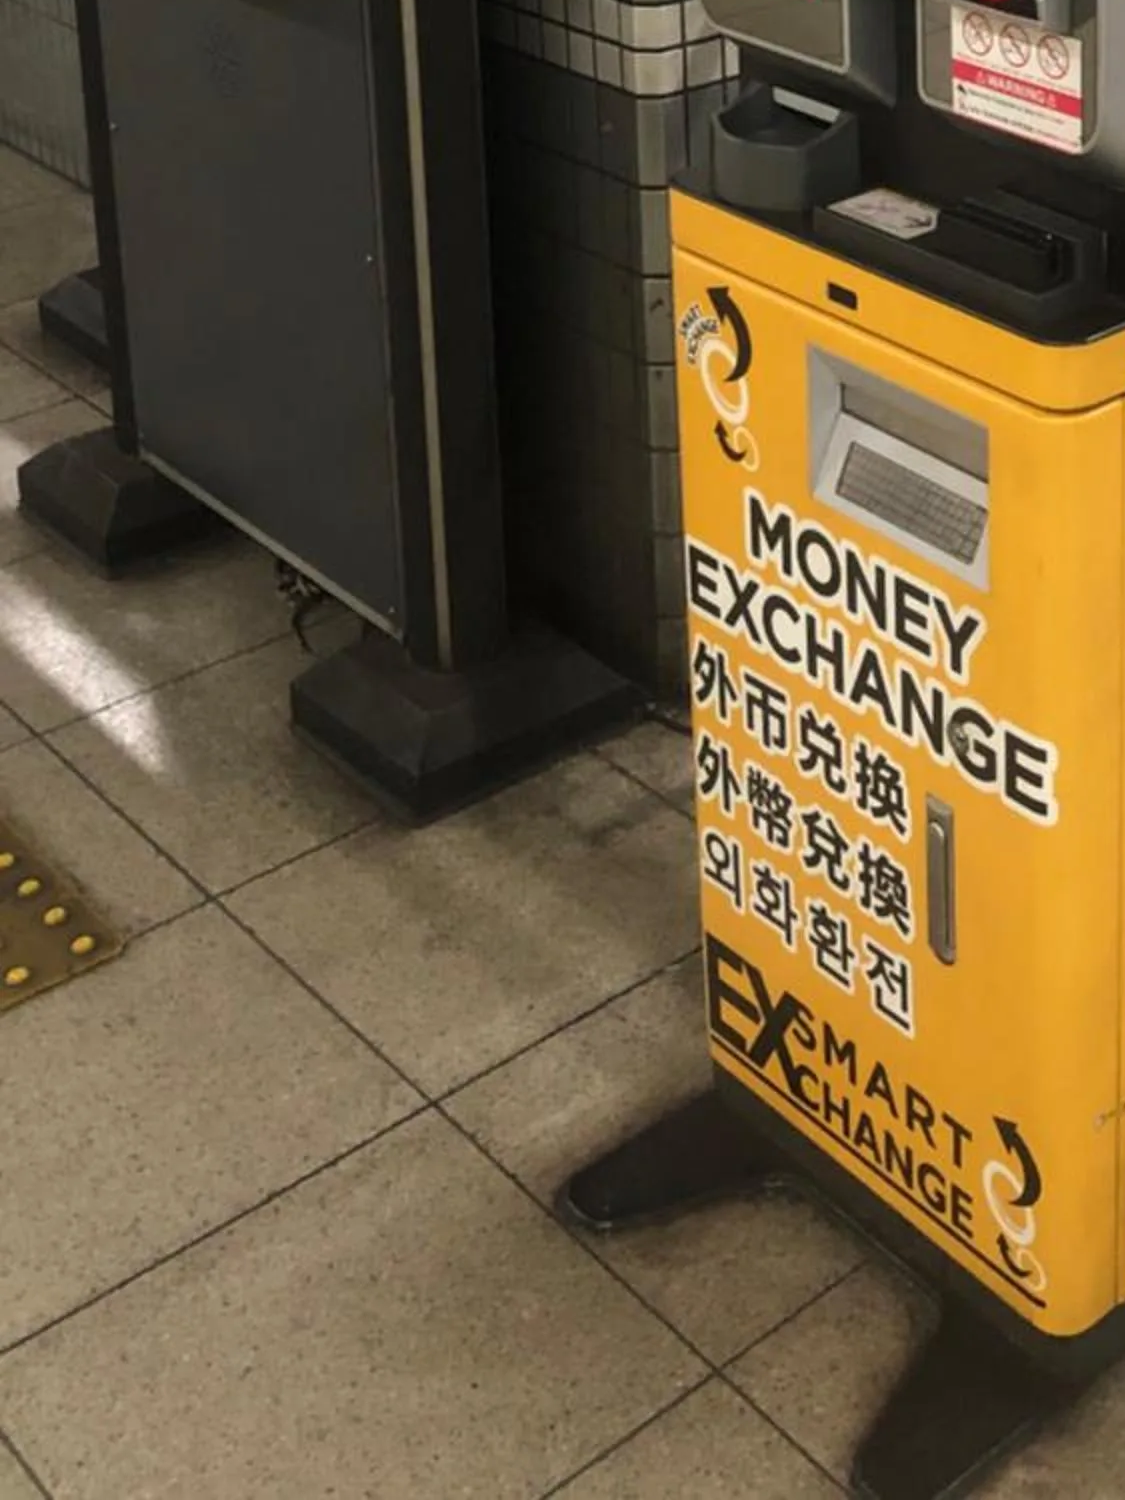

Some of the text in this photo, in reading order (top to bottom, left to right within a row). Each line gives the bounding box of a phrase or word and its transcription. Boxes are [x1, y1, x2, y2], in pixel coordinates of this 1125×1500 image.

[688, 544, 1050, 818] EXCHANGE
[748, 493, 979, 676] MONEY
[692, 639, 909, 836] 外币兑换
[703, 831, 911, 1032] 외화환전
[790, 1001, 973, 1170] SMART
